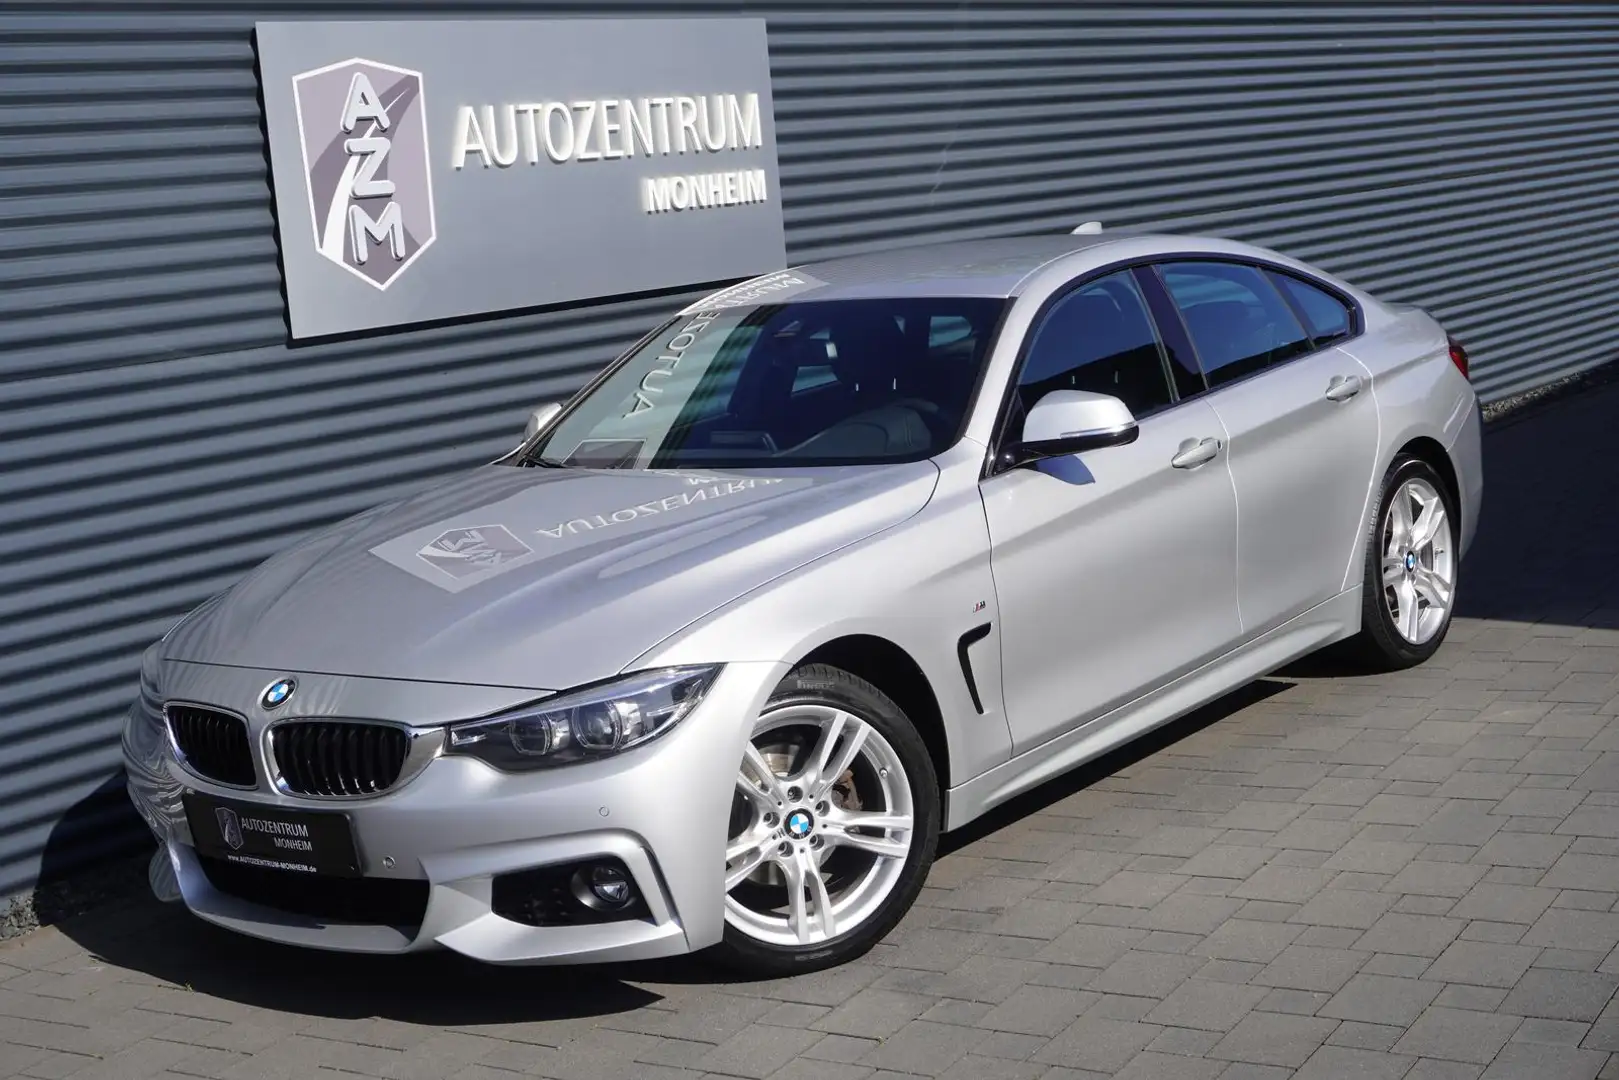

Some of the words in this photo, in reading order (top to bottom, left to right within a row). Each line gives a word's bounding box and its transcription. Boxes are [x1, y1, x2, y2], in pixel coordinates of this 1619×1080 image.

[454, 93, 763, 169] AUTOZENTRUM
[340, 71, 405, 265] AZM
[644, 170, 768, 213] MONHEIM
[241, 817, 309, 837] AUTOZENTRUM
[274, 837, 313, 851] MONHEIM
